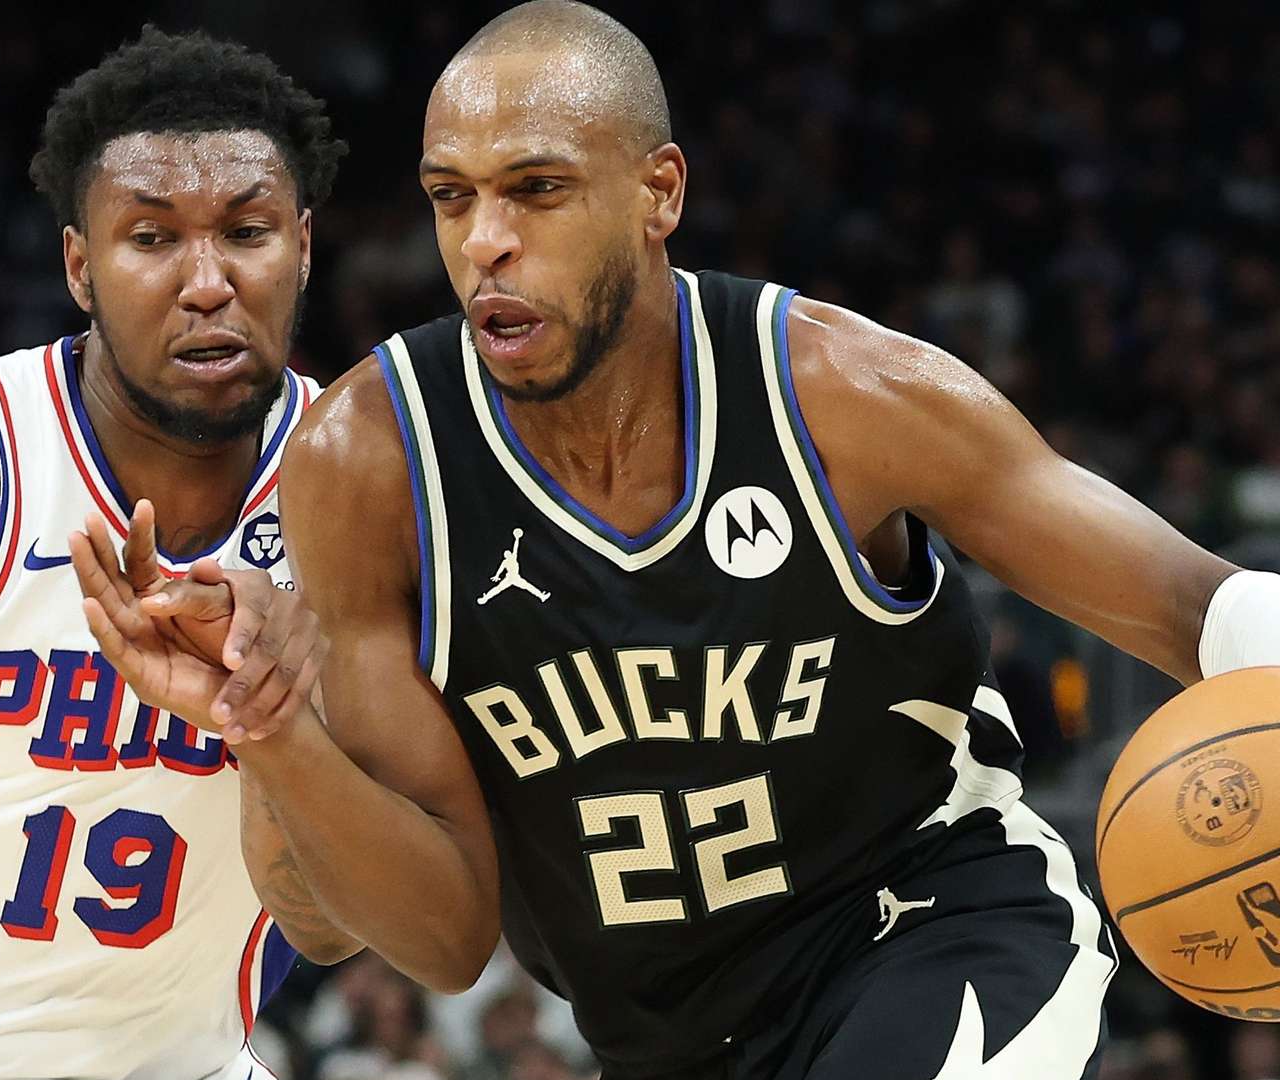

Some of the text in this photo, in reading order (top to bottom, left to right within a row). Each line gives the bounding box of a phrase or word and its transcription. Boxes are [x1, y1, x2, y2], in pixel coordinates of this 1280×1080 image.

[463, 634, 839, 779] BUCKS
[0, 805, 188, 949] 19
[573, 771, 794, 930] 22
